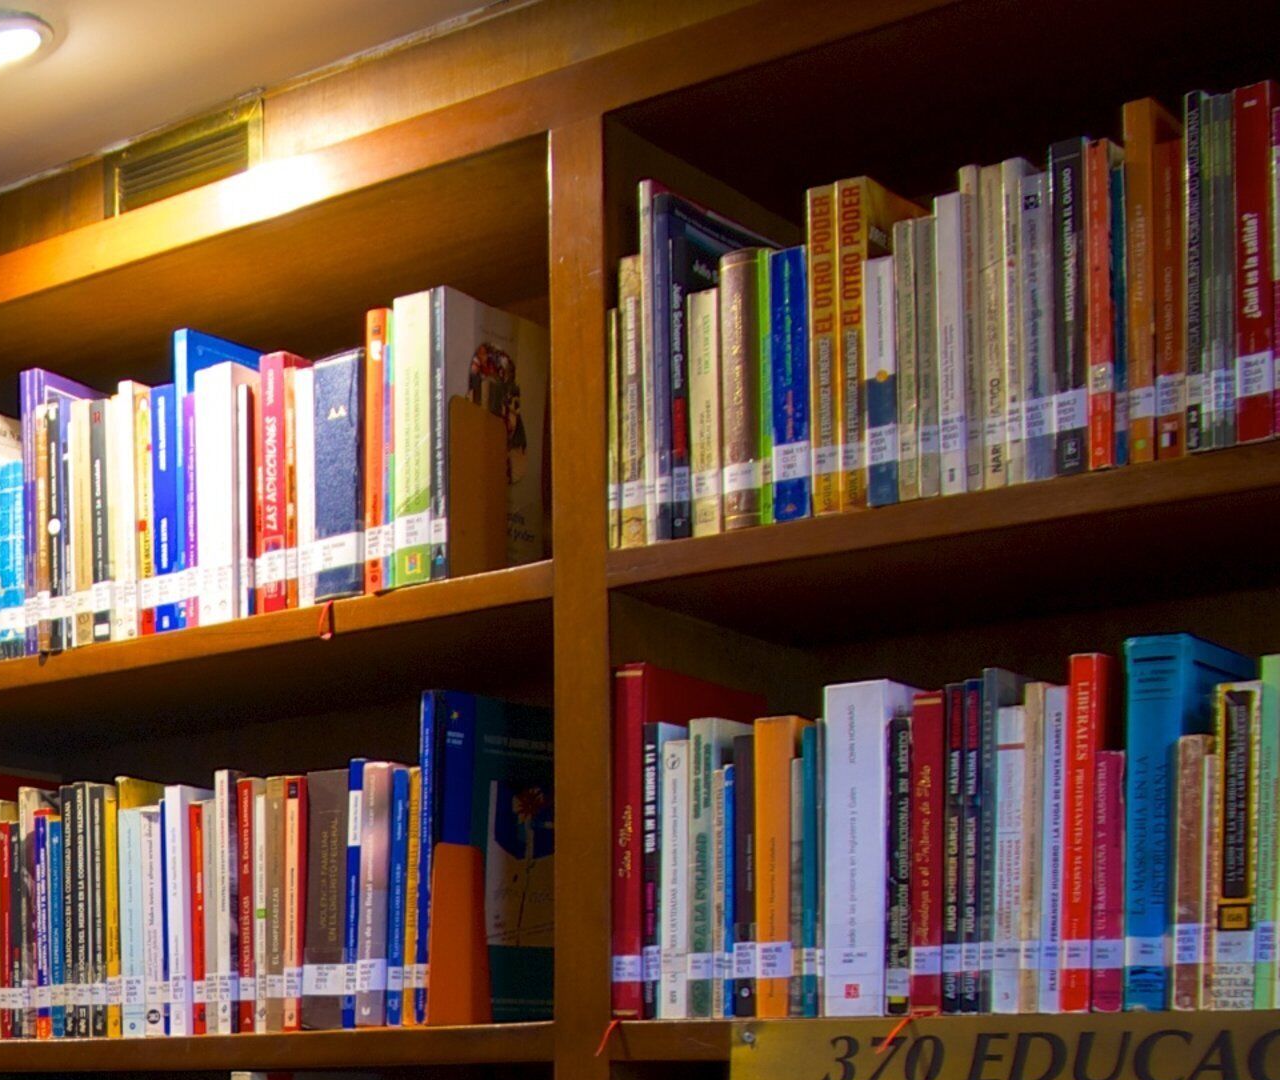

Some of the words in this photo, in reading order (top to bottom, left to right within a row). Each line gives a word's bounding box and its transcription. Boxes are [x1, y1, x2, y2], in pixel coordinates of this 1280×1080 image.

[1061, 168, 1073, 203] OLVIDO
[810, 194, 831, 254] PODER
[840, 185, 860, 245] PODER
[1062, 205, 1073, 218] EL
[1063, 220, 1075, 258] CONTRA
[1243, 212, 1259, 254] salida?
[842, 253, 860, 300] OTRO
[1243, 257, 1259, 269] la
[1246, 270, 1260, 282] es
[813, 260, 832, 309] OTRO
[1243, 284, 1262, 318] ¿Cuál
[814, 313, 832, 334] EL
[842, 304, 860, 325] EL
[266, 504, 277, 530] LAS
[1075, 681, 1088, 760] LIBERALES
[645, 766, 655, 803] SOMBRA
[645, 805, 655, 816] DE
[645, 819, 654, 831] MI
[645, 833, 654, 854] VIDA
[949, 816, 959, 854] GARCÍA
[966, 817, 976, 855] GARCÍA
[948, 856, 958, 903] SCHERER
[966, 857, 976, 903] SCHERER
[948, 905, 957, 932] JULIO
[965, 906, 975, 933] JULIO
